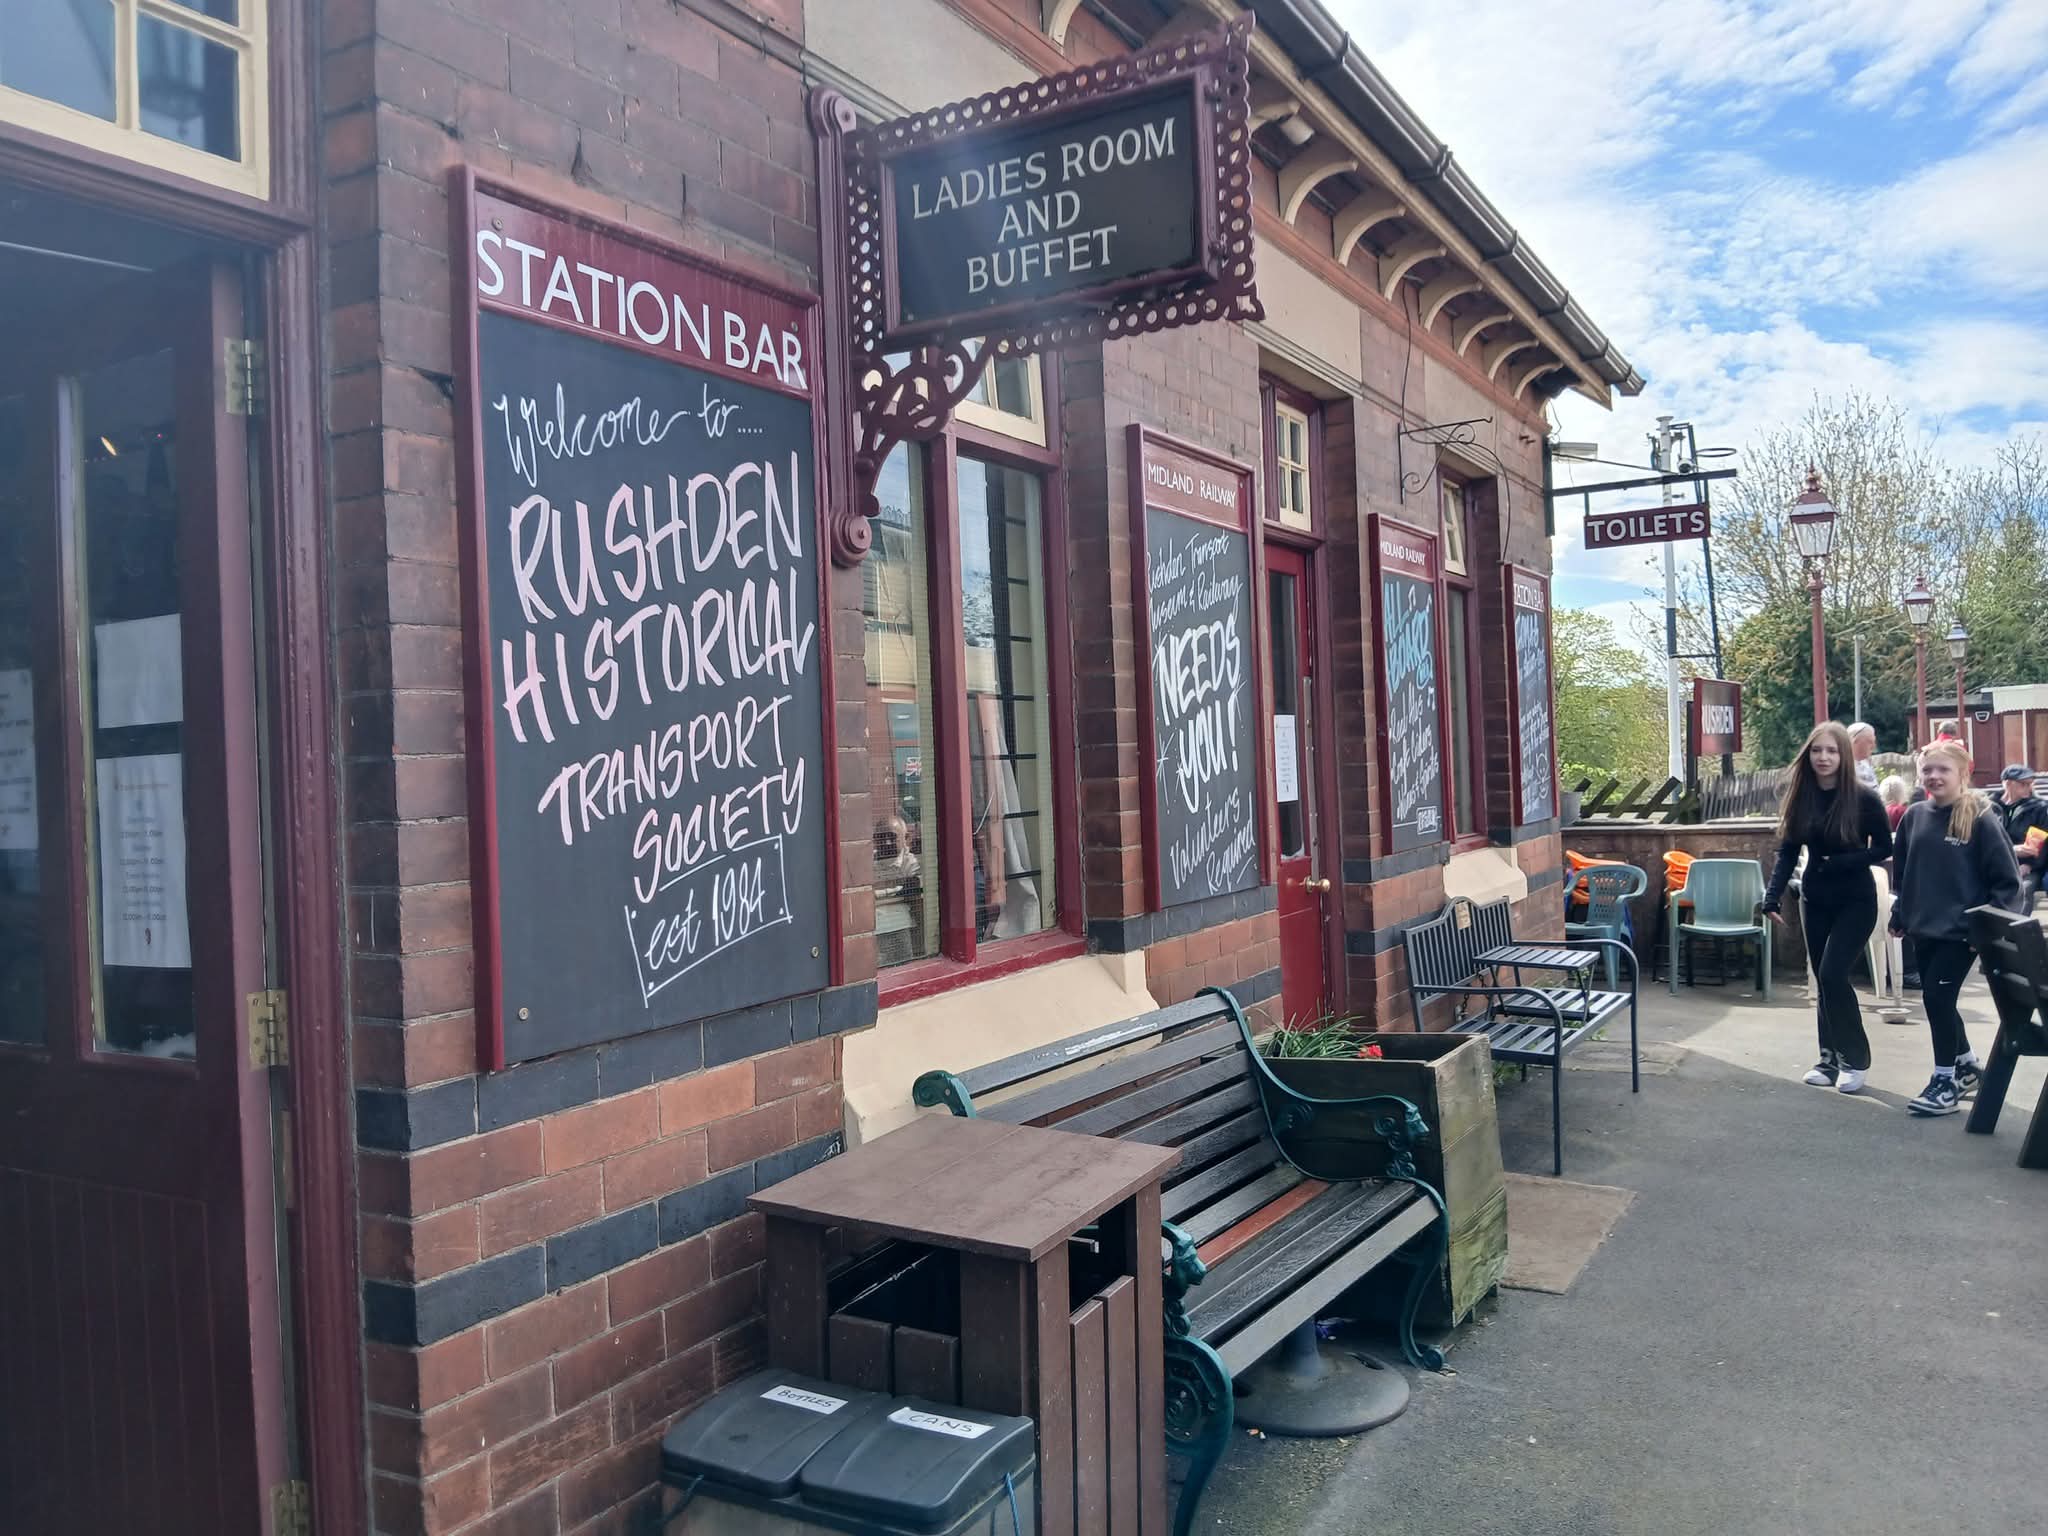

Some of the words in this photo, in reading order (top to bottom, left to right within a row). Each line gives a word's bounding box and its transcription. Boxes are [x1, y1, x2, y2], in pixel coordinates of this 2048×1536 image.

[912, 151, 1048, 220] LADIES
[1060, 117, 1176, 183] ROOM
[997, 190, 1081, 243] AND
[476, 229, 711, 360] STATION
[723, 310, 808, 389] BAR
[966, 224, 1118, 294] BUFFET
[492, 383, 690, 488] Welcome
[1147, 463, 1194, 495] MIDLAND
[1200, 479, 1236, 509] RAILWAY
[507, 450, 802, 624] RUSHDEN
[1587, 511, 1706, 542] TOILETS
[502, 566, 815, 743] HISTORICAL
[1160, 613, 1241, 726] NEEDS
[538, 695, 793, 845] TRANSPORT
[632, 757, 805, 904] SOCIETY
[1170, 786, 1241, 890] Volunteers
[645, 889, 702, 970] est
[711, 857, 765, 947] 1984
[909, 1414, 972, 1433] CANS
